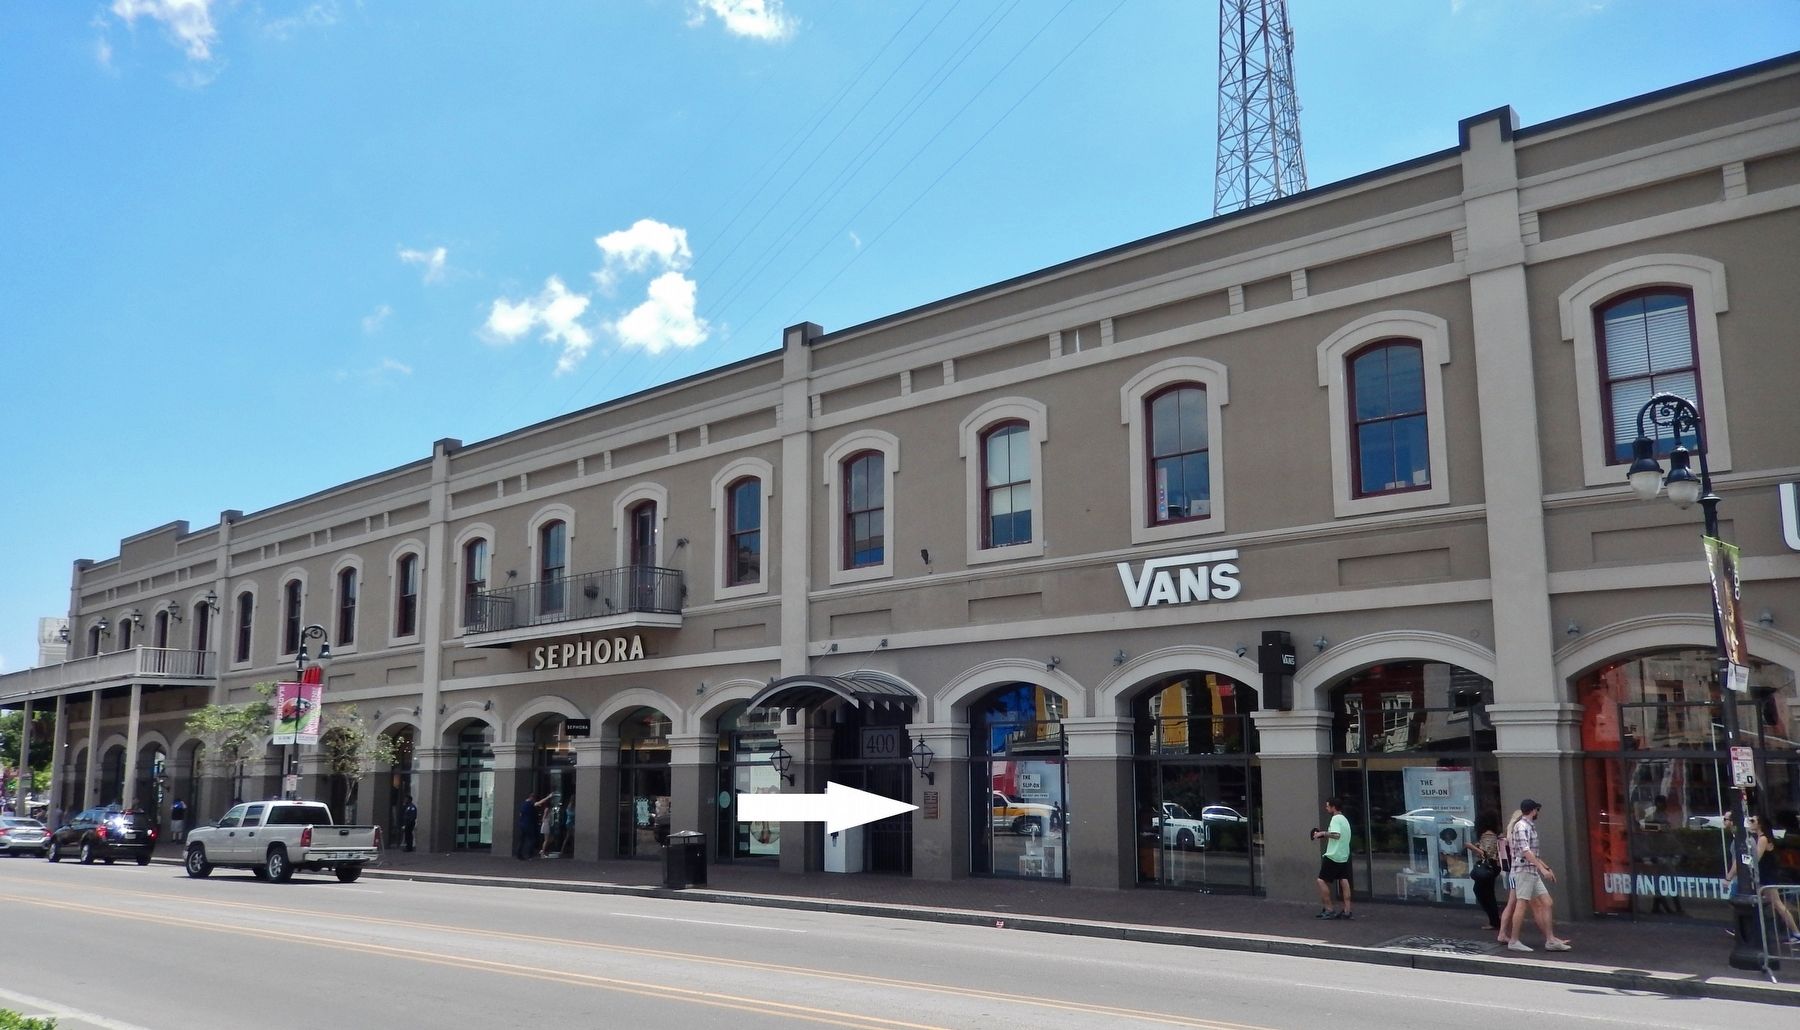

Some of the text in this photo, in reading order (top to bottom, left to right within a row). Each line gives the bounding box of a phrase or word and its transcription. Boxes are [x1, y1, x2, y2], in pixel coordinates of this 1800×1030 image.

[1117, 549, 1241, 608] VANS
[534, 634, 645, 670] SEPHORA
[1281, 654, 1295, 665] VANS
[566, 723, 589, 731] SEPHORA
[866, 734, 895, 754] 400
